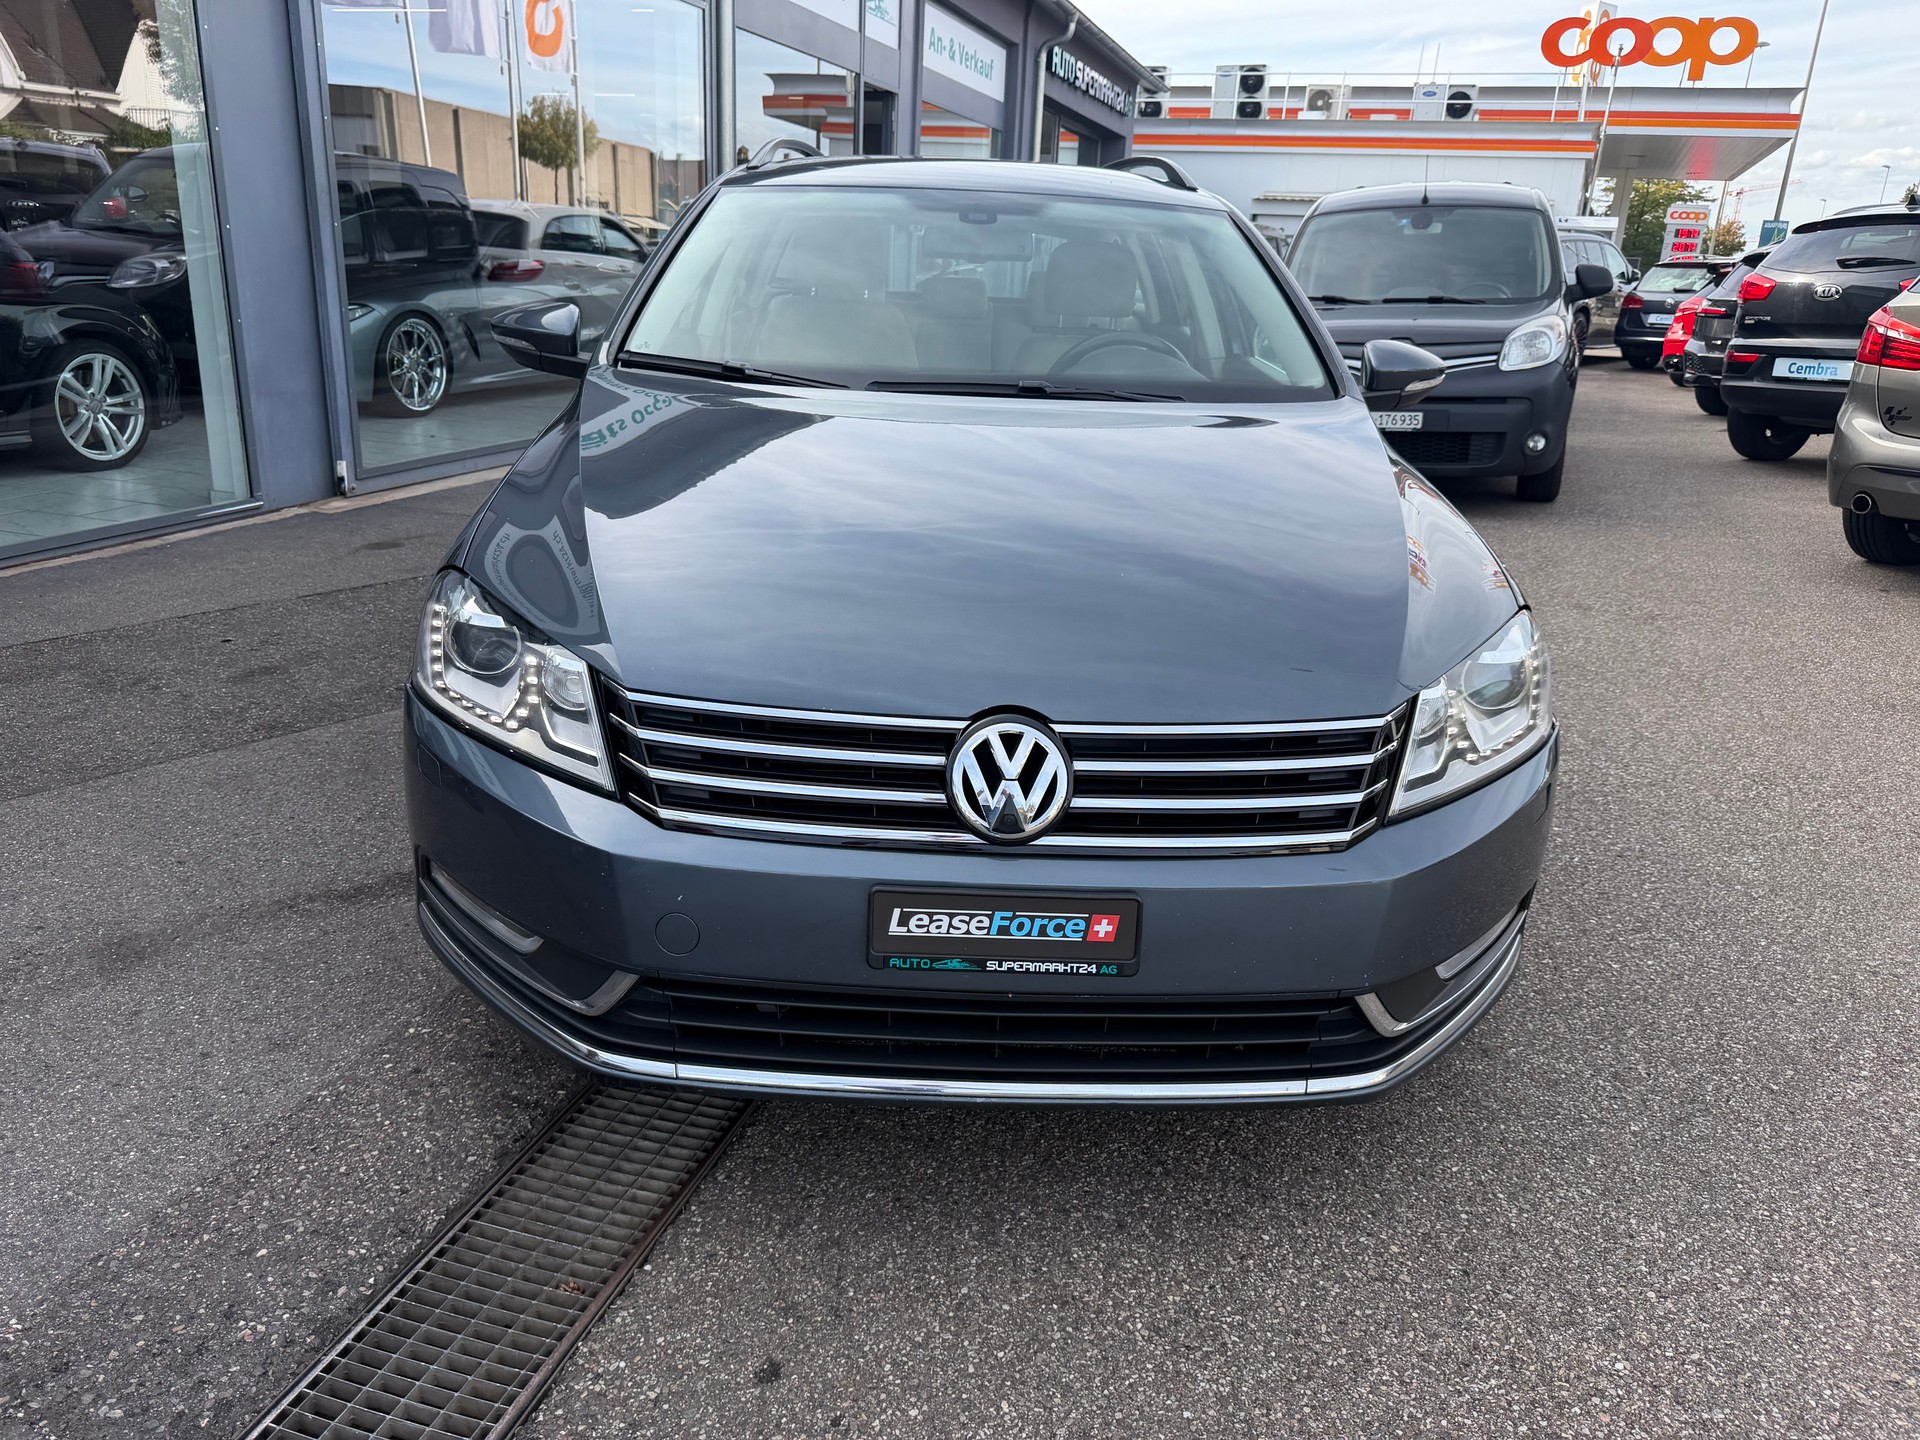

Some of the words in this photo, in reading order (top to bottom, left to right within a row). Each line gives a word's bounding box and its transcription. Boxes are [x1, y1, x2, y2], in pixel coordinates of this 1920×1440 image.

[929, 27, 946, 55] An-
[948, 37, 956, 62] &
[958, 42, 994, 80] Verkauf
[1052, 45, 1076, 82] AUTO
[1541, 17, 1759, 81] coop
[1669, 210, 1708, 223] coop
[1816, 287, 1837, 297] KIA
[1787, 362, 1839, 377] Cembra
[951, 722, 1068, 833] VW
[889, 907, 1087, 938] LeaseForce
[889, 957, 931, 969] AUTO
[985, 960, 1098, 975] SUPERMARKT24
[1099, 964, 1118, 975] AG
